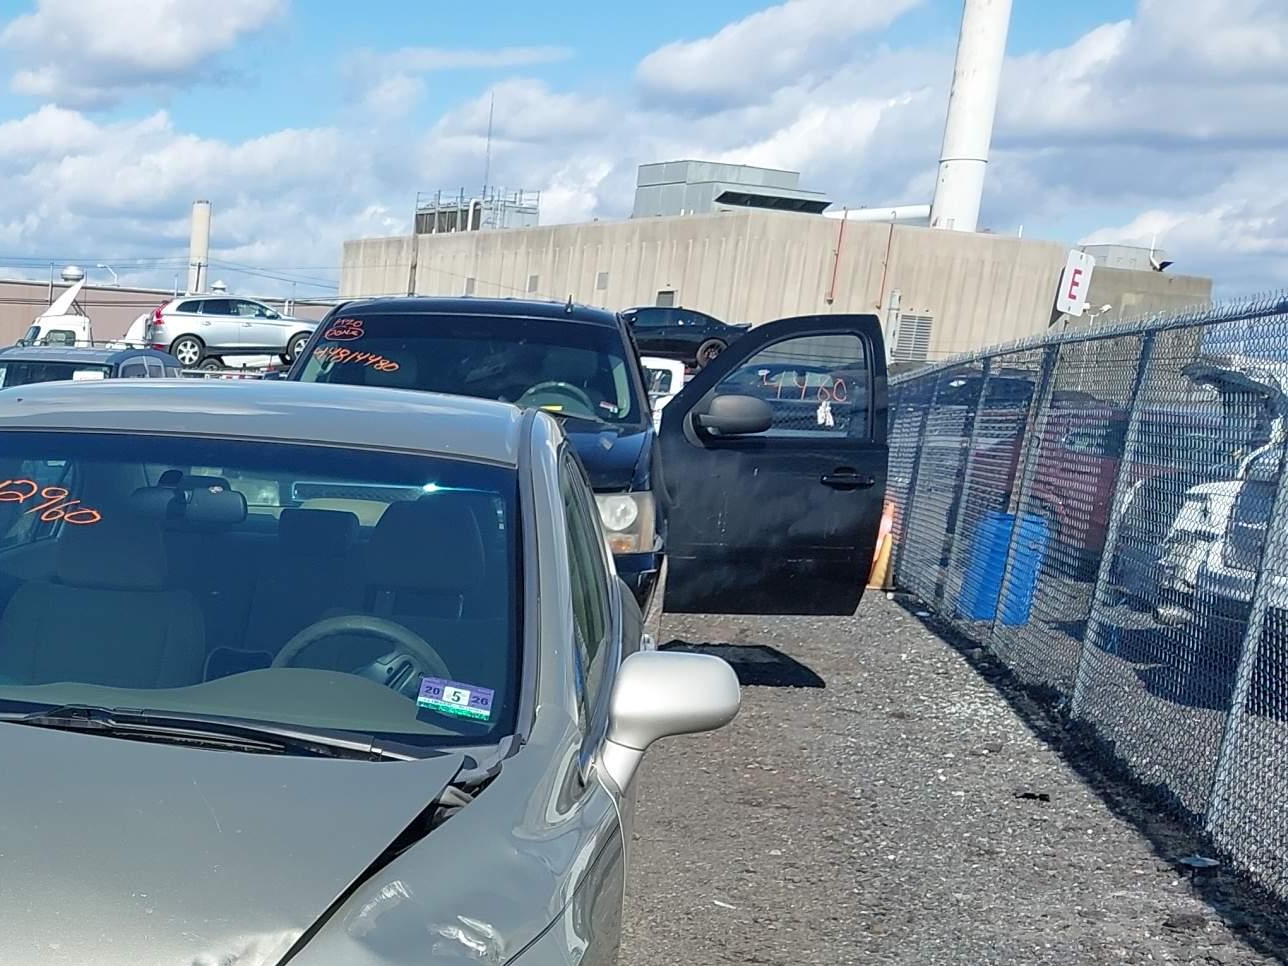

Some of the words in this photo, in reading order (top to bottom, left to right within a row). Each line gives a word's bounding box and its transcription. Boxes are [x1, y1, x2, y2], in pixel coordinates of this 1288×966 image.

[1068, 268, 1083, 300] E
[313, 346, 399, 372] 44814480
[424, 685, 440, 696] 20
[451, 691, 462, 703] 5
[471, 696, 489, 706] 26
